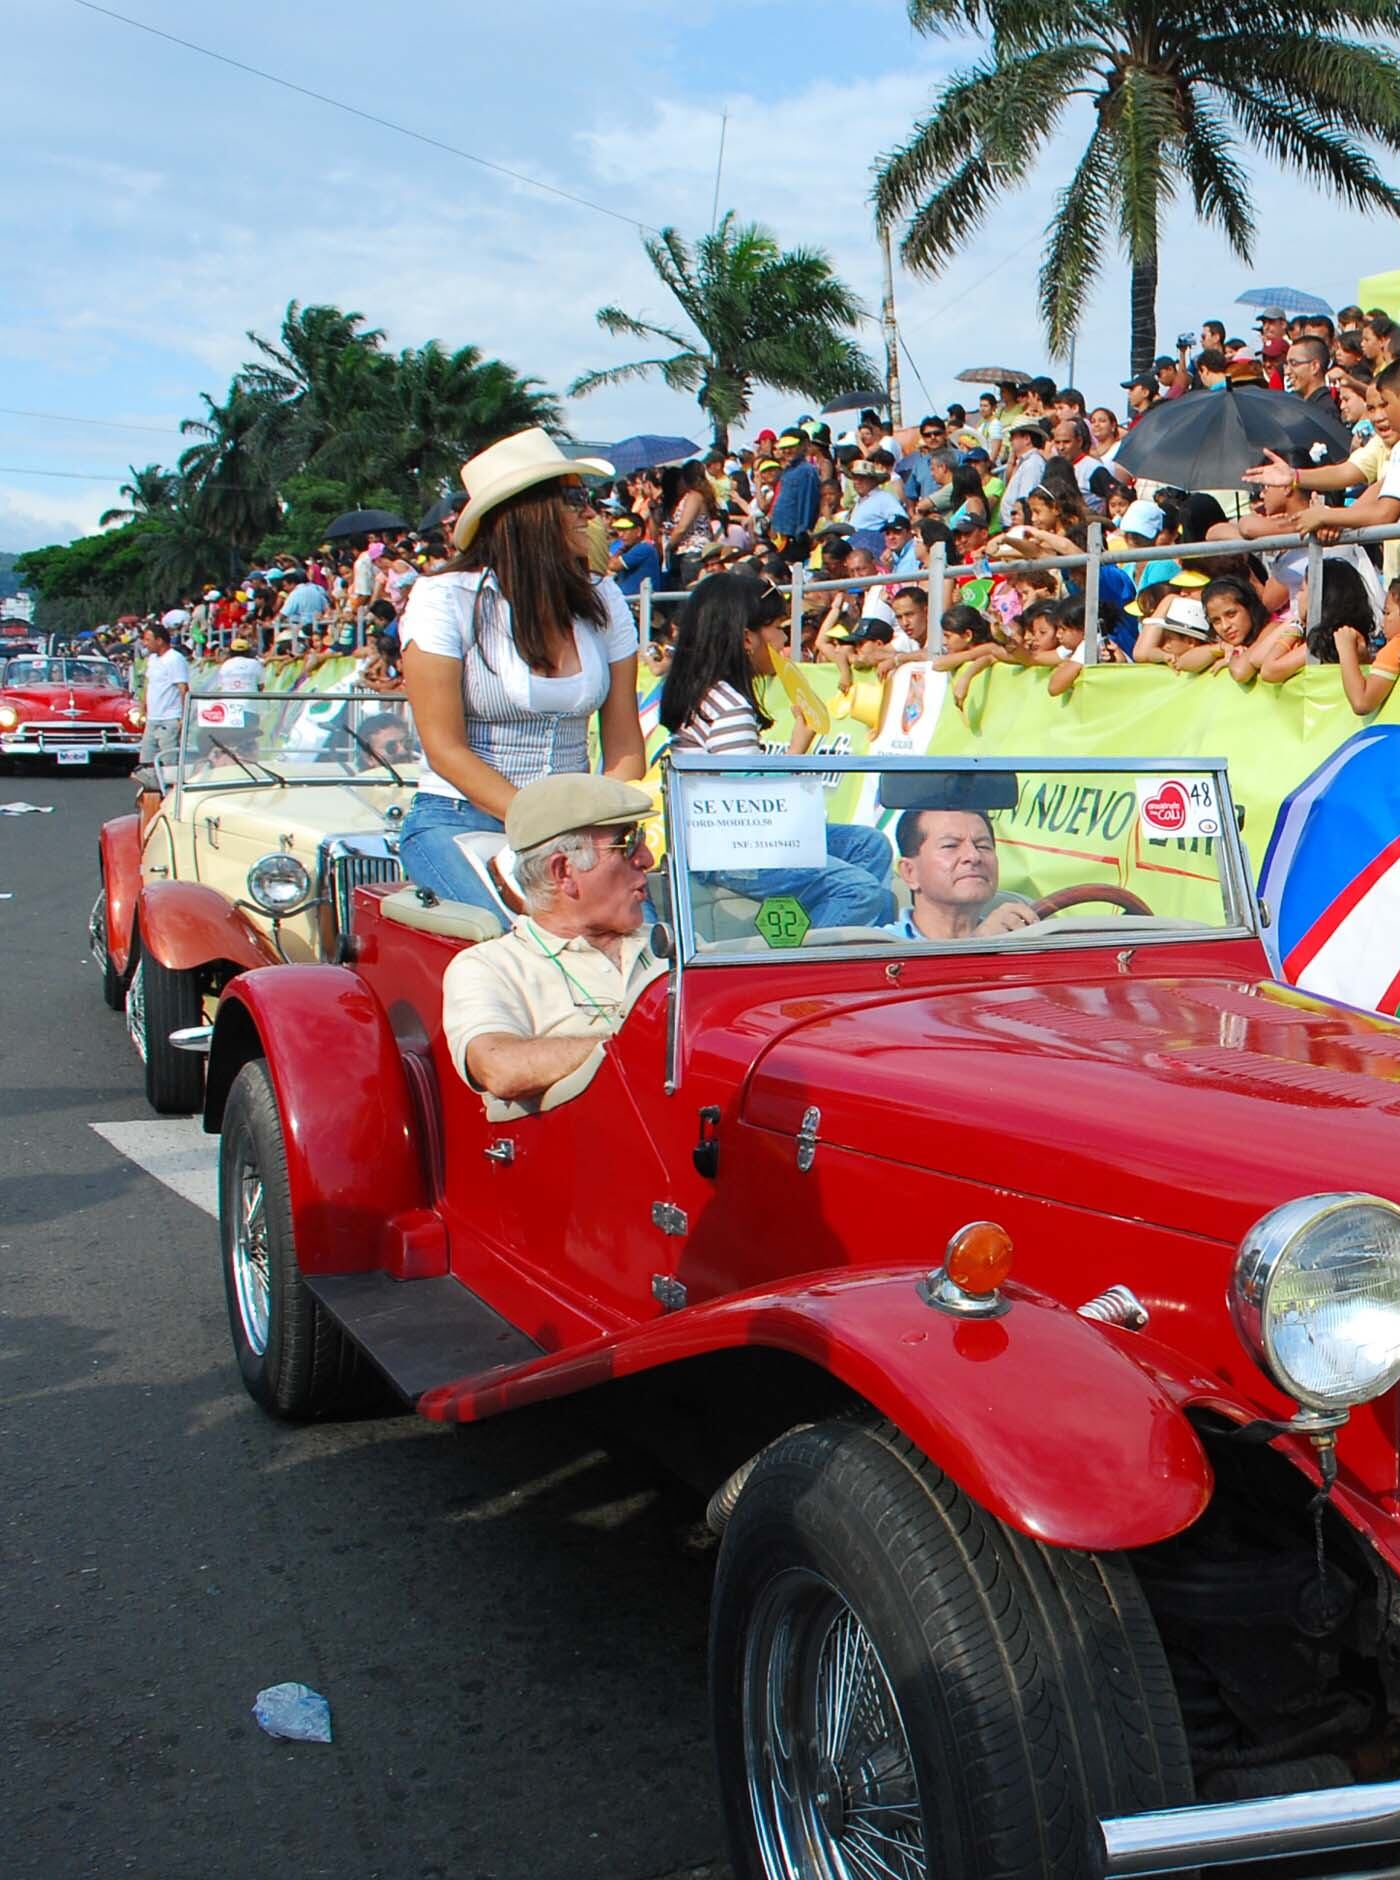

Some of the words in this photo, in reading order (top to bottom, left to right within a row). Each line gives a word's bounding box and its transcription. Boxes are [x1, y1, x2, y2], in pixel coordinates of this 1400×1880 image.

[693, 799, 717, 815] SE
[722, 798, 788, 814] VENDE
[1190, 781, 1212, 807] 48
[1025, 783, 1136, 841] NUEVO
[768, 911, 797, 937] 92
